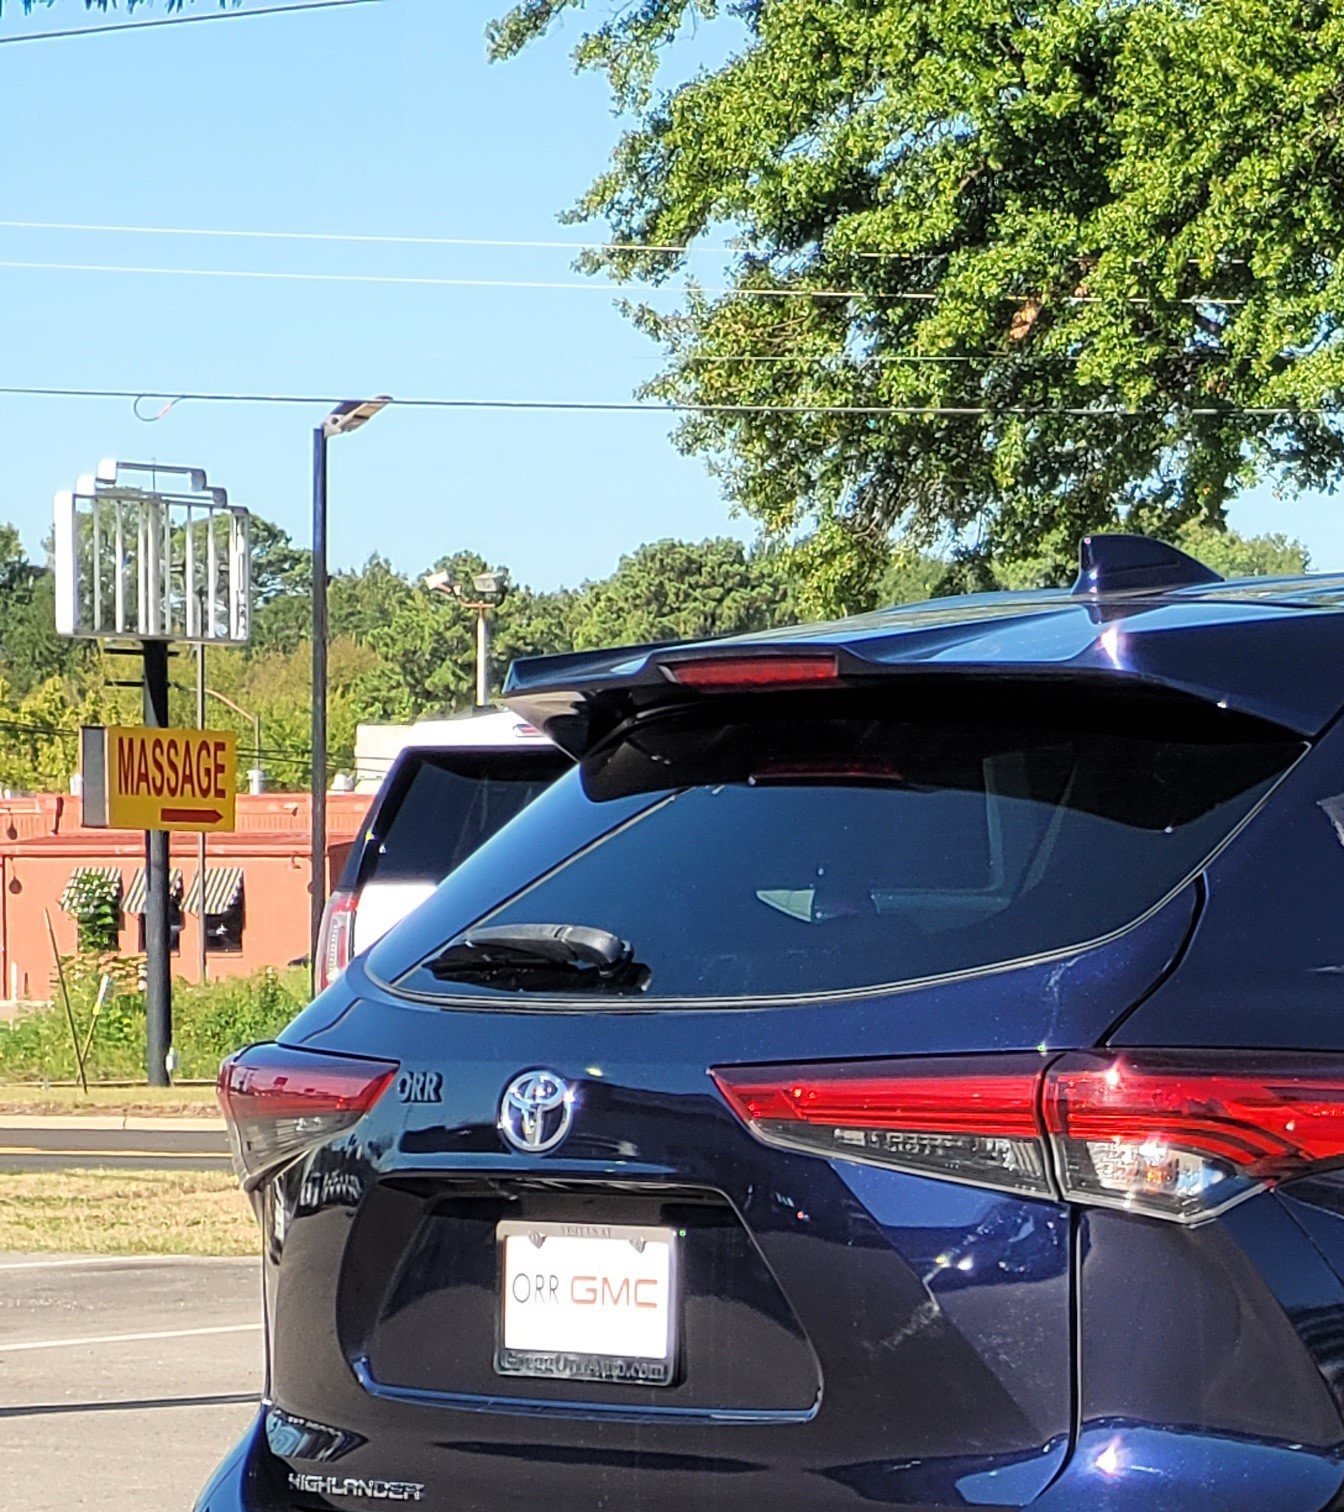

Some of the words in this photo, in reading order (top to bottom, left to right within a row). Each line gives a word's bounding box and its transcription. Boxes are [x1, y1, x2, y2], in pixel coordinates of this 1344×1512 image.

[118, 736, 226, 799] MASSAGE
[399, 1071, 444, 1104] ORR
[512, 1272, 560, 1304] ORR
[570, 1275, 658, 1309] GMC
[288, 1472, 425, 1501] HIGHLANDER
